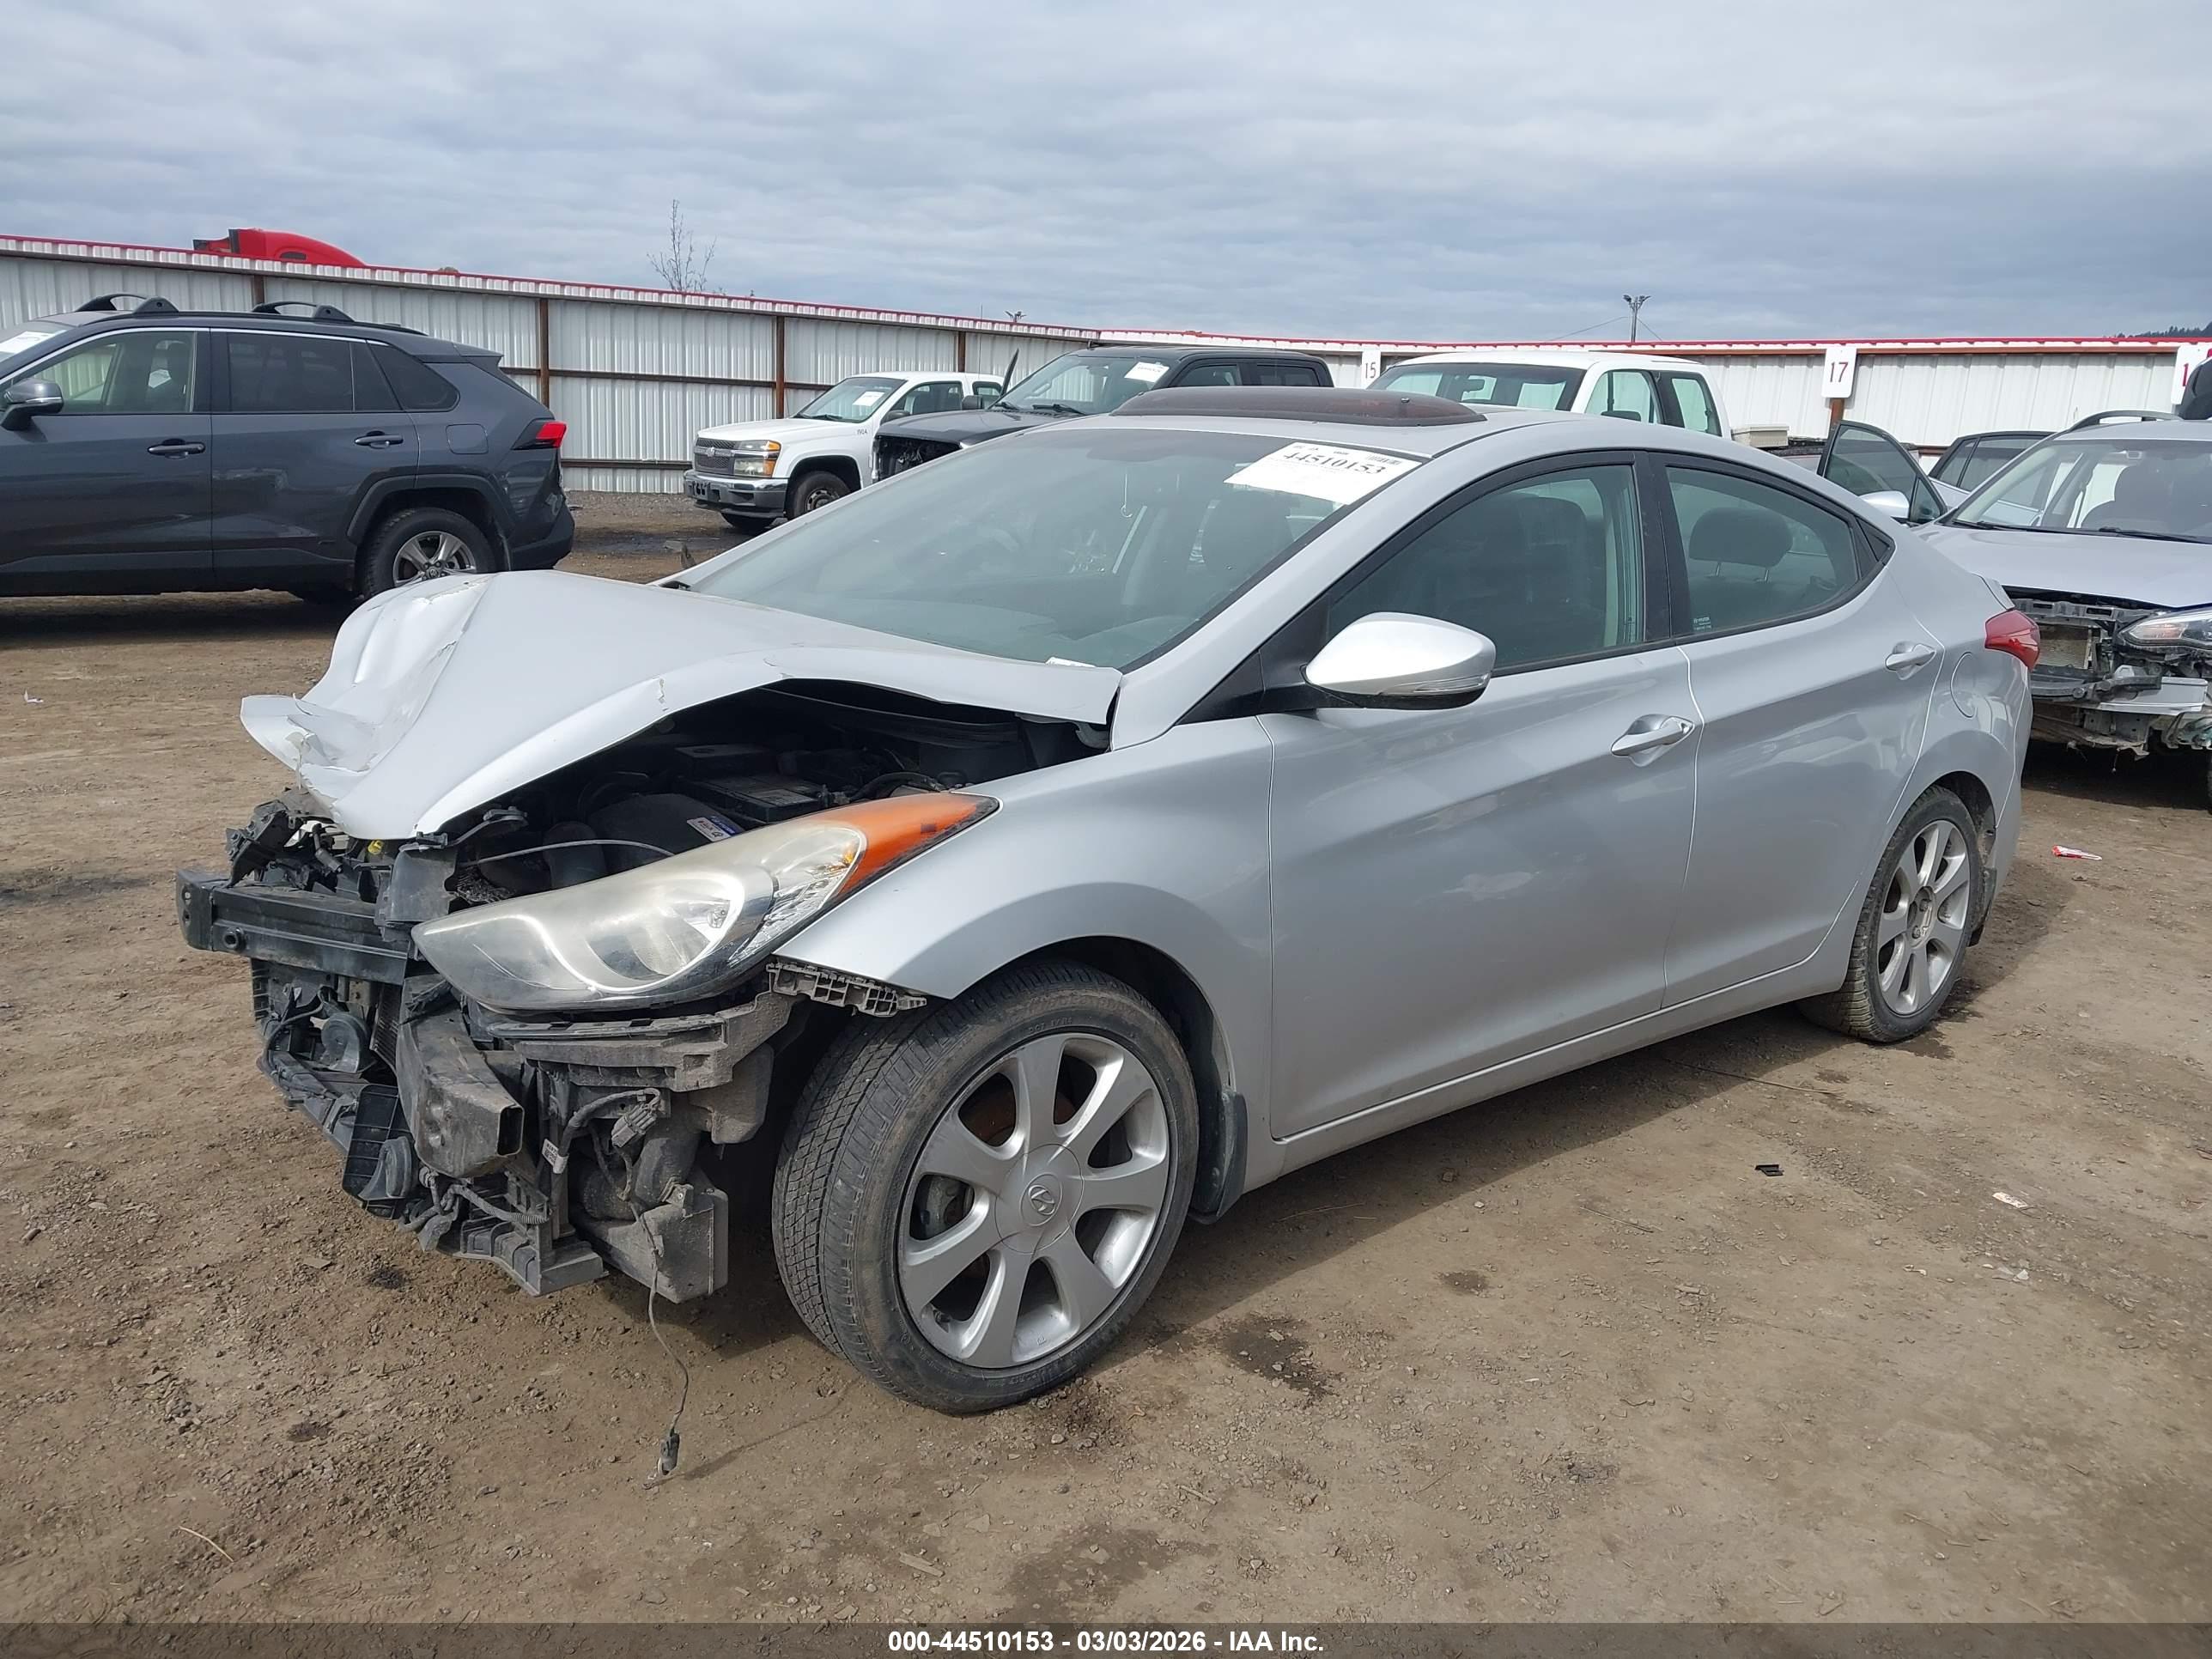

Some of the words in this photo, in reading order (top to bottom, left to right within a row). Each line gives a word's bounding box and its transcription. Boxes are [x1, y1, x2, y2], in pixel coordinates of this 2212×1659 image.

[1364, 362, 1376, 379] 15
[1829, 361, 1849, 383] 17
[1284, 452, 1386, 474] 44510153
